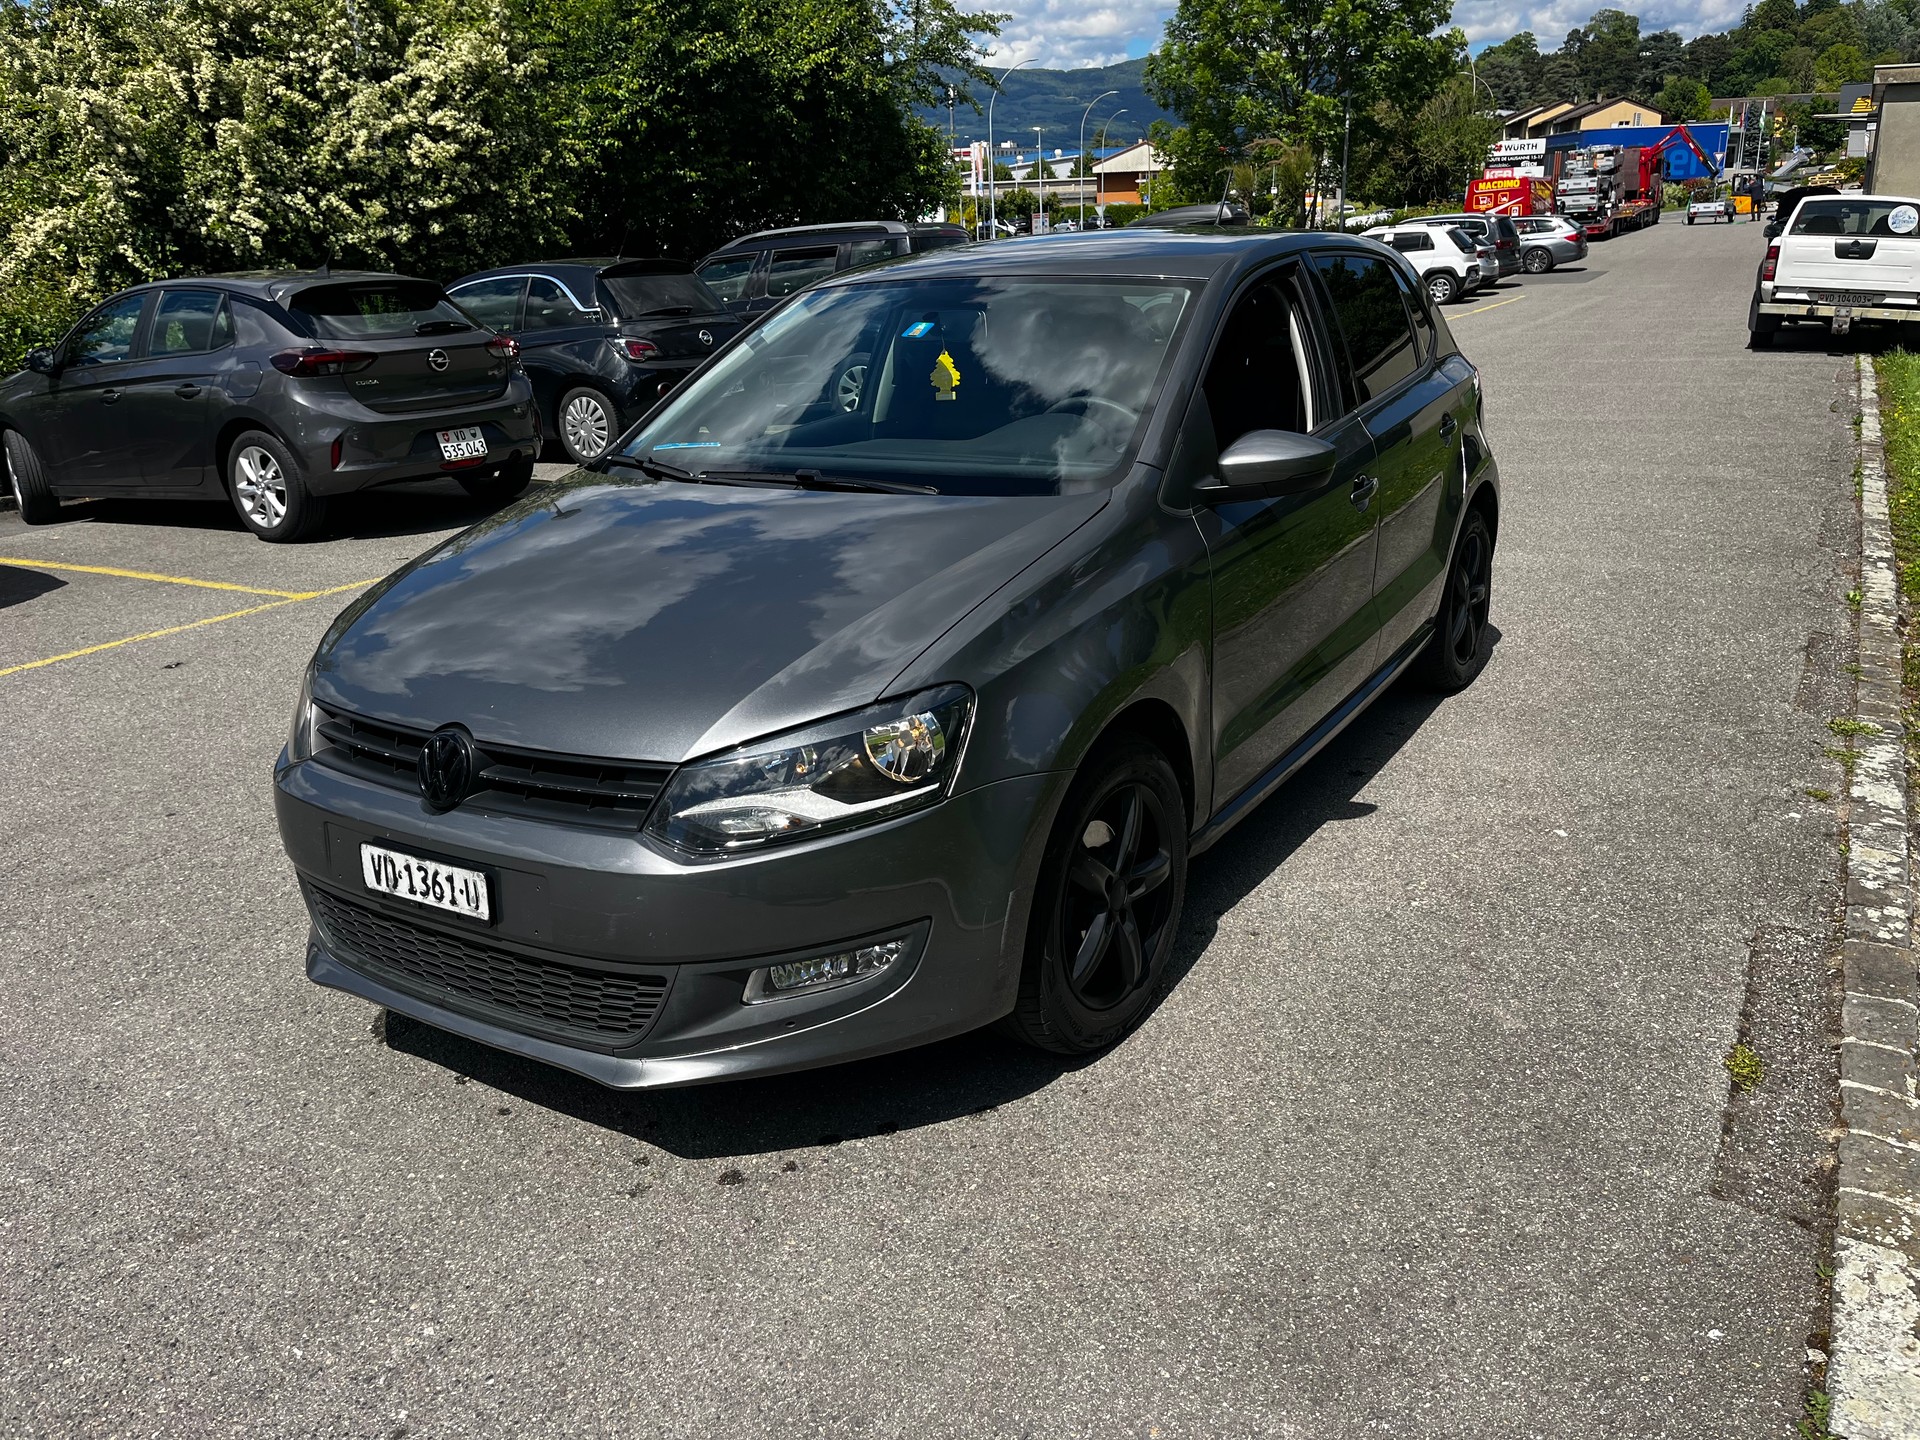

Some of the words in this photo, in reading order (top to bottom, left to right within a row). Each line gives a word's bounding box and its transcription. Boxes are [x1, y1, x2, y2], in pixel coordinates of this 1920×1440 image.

[1478, 180, 1520, 190] MACDIMO
[453, 430, 466, 441] VD
[443, 443, 465, 458] 535
[465, 441, 486, 455] 043
